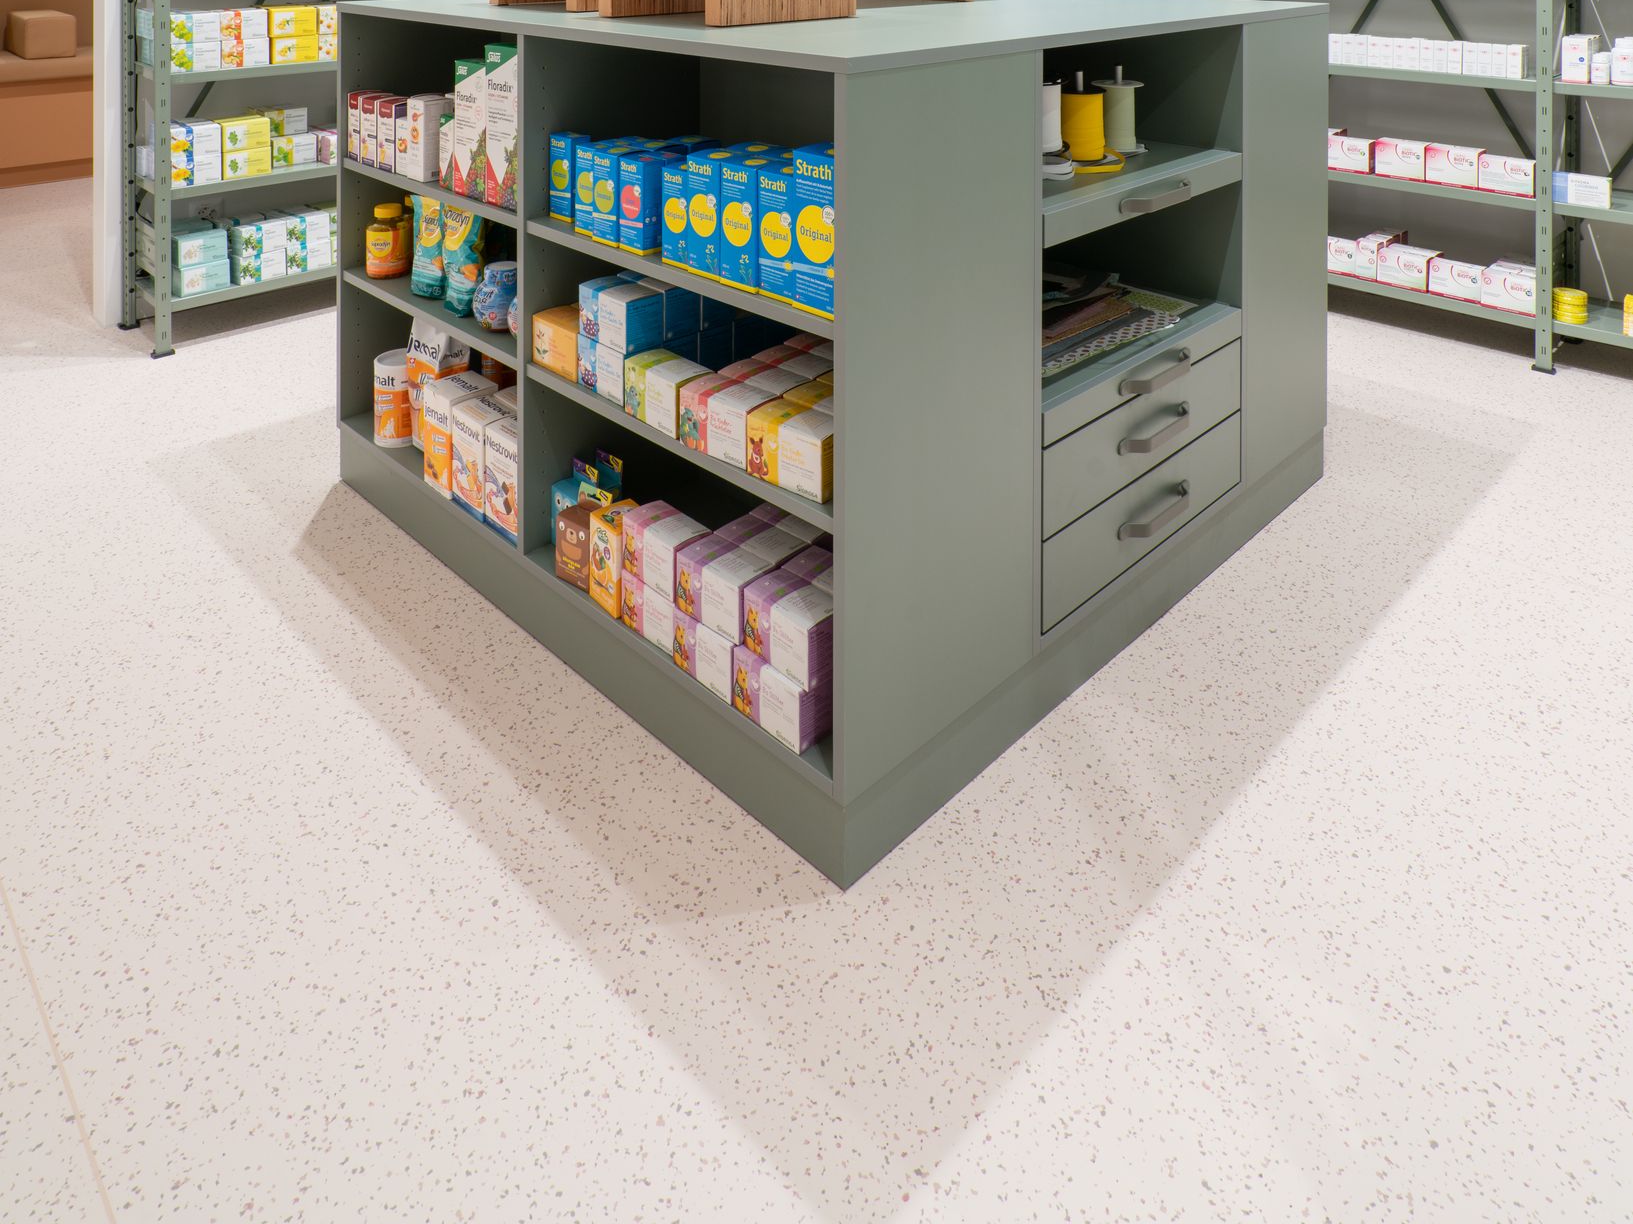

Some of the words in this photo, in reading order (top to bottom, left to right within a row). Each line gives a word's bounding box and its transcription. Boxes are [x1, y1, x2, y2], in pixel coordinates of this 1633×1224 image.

[487, 78, 512, 94] Floradix
[456, 91, 476, 104] Floradix
[551, 139, 566, 148] Strath
[577, 149, 592, 160] Strath
[594, 156, 610, 167] Strath
[621, 162, 637, 173] Strath
[688, 161, 712, 176] Strath
[796, 159, 832, 181] Strath
[664, 172, 682, 184] Strath
[723, 168, 748, 183] Strath
[760, 176, 786, 193] Strath
[666, 210, 684, 221] Original
[692, 210, 714, 223] Original
[725, 218, 749, 231] Original
[764, 228, 789, 242] Original
[800, 226, 832, 244] Original
[424, 402, 448, 428] jemalt
[452, 414, 480, 443] Nestrovit
[486, 434, 518, 464] Nestrovit
